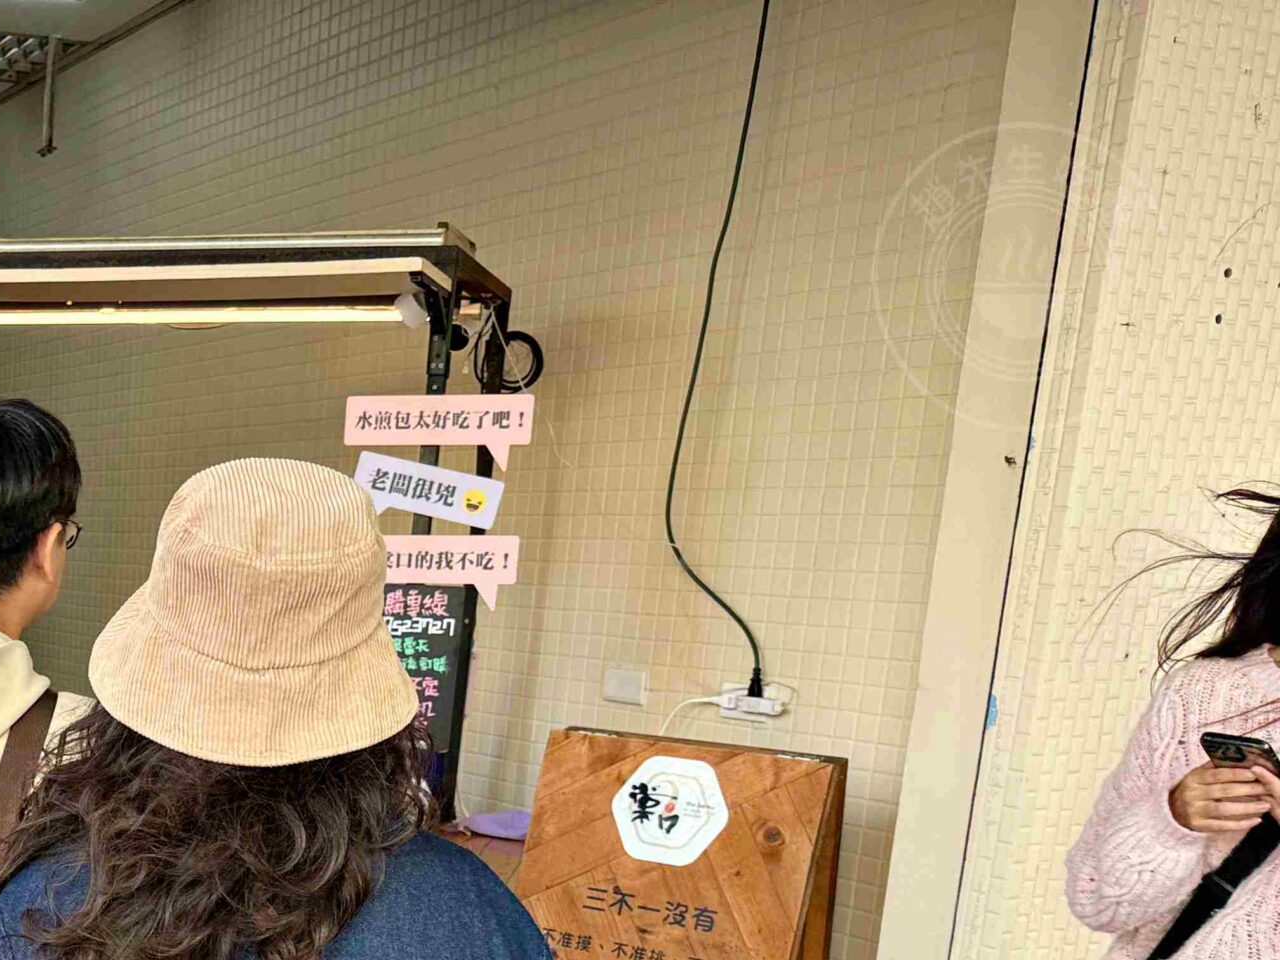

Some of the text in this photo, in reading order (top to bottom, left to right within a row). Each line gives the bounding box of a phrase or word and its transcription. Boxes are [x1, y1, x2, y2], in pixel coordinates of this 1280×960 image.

[355, 410, 525, 431] 水煎包太好吃了吧！
[367, 467, 458, 508] 老闆很兇
[582, 886, 718, 933] 三不一沒有
